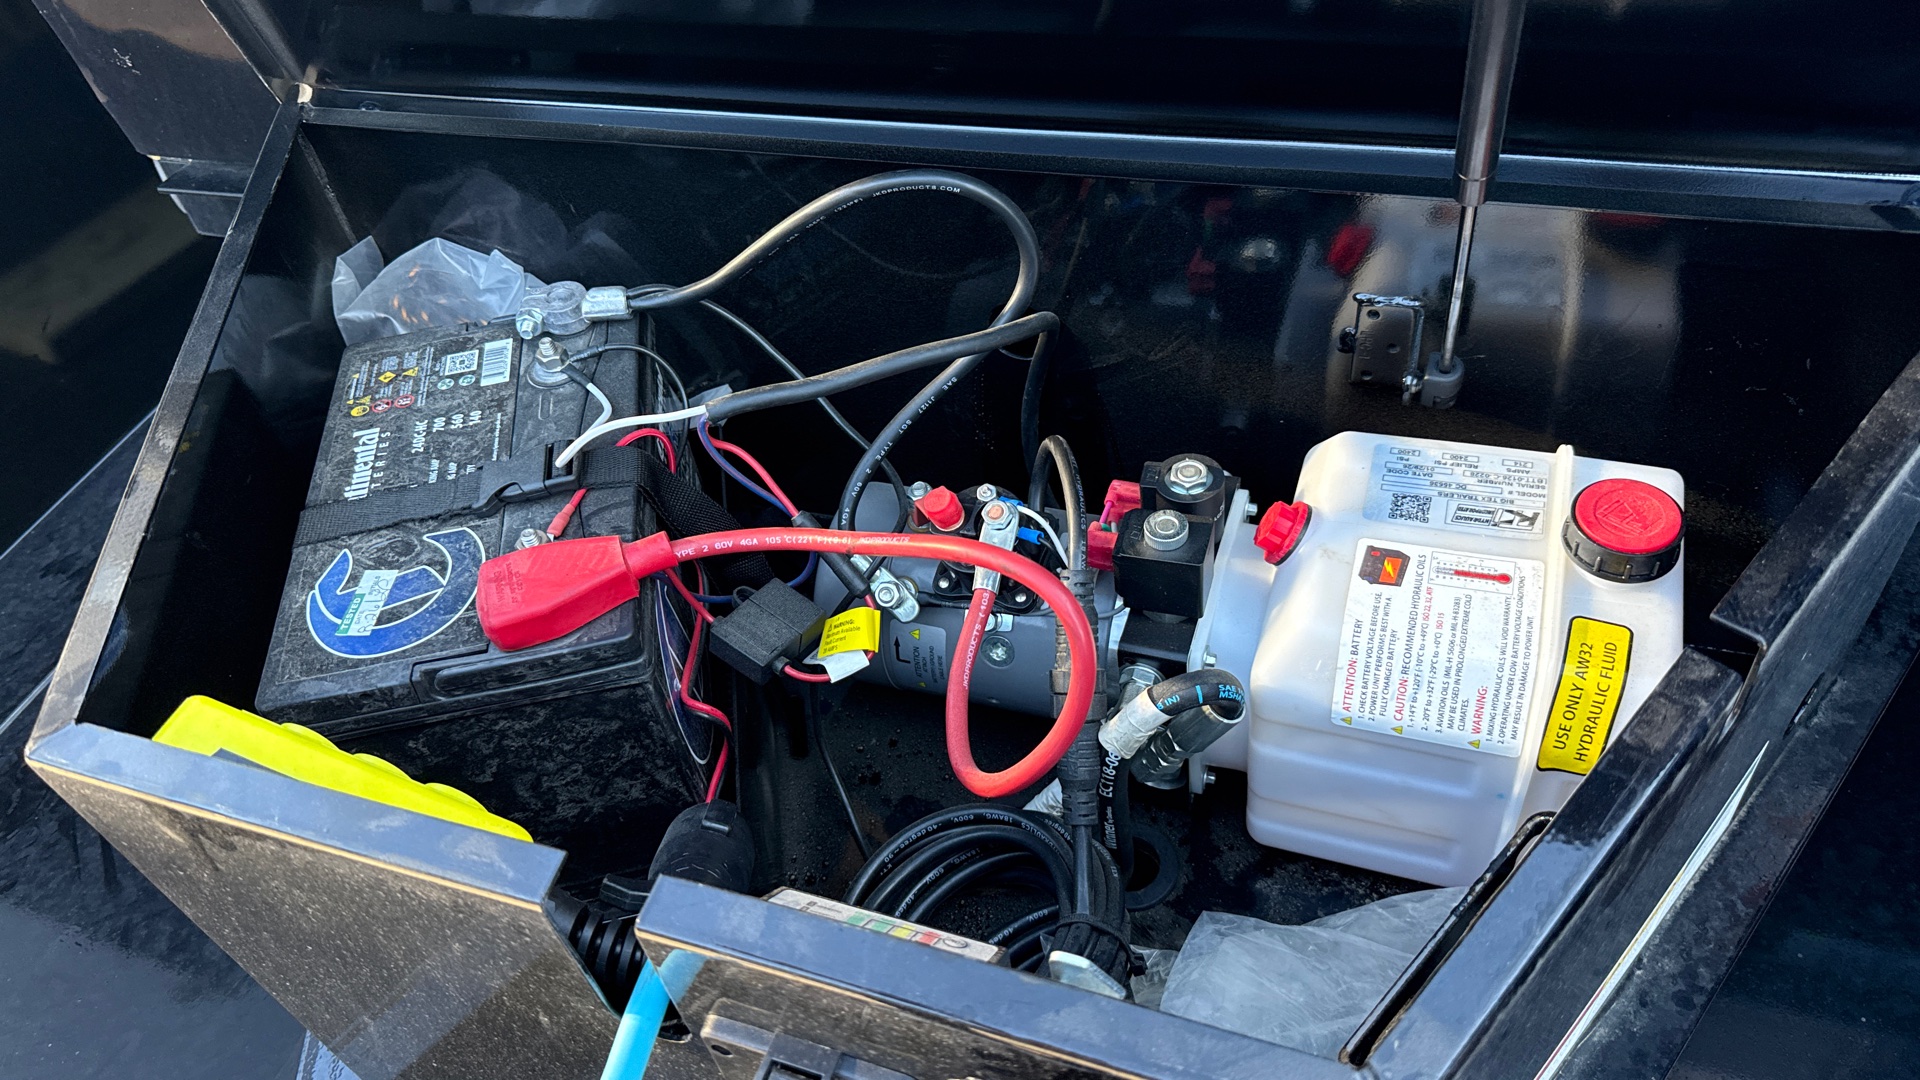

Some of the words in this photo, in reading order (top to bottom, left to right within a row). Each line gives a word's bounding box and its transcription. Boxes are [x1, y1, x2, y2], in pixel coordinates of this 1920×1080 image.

[942, 376, 958, 391] SAE
[918, 396, 935, 414] J1127
[432, 417, 445, 431] 700
[451, 414, 463, 428] 560
[469, 411, 481, 424] 140
[875, 441, 893, 461] TYPE
[1449, 461, 1478, 469] RELIEF
[852, 482, 862, 497] 60V
[1476, 478, 1513, 486] NUMBER
[1076, 474, 1086, 530] HYDRAULICS
[1437, 491, 1478, 500] TRAILERS
[1515, 490, 1545, 498] MODEL
[841, 507, 850, 525] 4GA
[1454, 515, 1489, 523] HYDRAULICS
[1457, 506, 1494, 514] INCORPORATED
[675, 548, 695, 559] YPE
[715, 541, 733, 550] 60V
[740, 538, 758, 546] 4GA
[1463, 593, 1472, 609] COLD
[1516, 575, 1525, 608] CONDITIONS
[340, 597, 360, 629] TESTED
[354, 611, 363, 624] DATE
[1370, 604, 1379, 626] BEFORE
[1382, 602, 1391, 617] WITH
[1514, 608, 1522, 632] VOLTAGE
[1380, 617, 1388, 632] BEST
[1461, 609, 1470, 634] EXTREME
[1365, 627, 1376, 659] VOLTAGE
[1393, 676, 1408, 721] CAUTION:
[1401, 609, 1418, 675] RECOMMENDED
[1410, 570, 1424, 609] HYDRAULIC
[1417, 553, 1426, 569] OILS
[1500, 626, 1508, 640] VOID
[1524, 629, 1533, 650] POWER
[1375, 633, 1386, 671] PERFORMS
[1386, 629, 1397, 659] BATTERY
[1447, 638, 1455, 655] 5606
[1499, 640, 1507, 655] WILL
[1511, 631, 1520, 658] BATTERY
[912, 646, 922, 677] ATTENTION
[1343, 657, 1358, 712] ATTENTION:
[1351, 618, 1363, 655] BATTERY
[1454, 635, 1467, 677] PROLONGED
[1497, 656, 1505, 672] OILS
[1522, 651, 1530, 660] TO
[1573, 641, 1593, 680] AW32
[1361, 659, 1371, 689] BATTERY
[1381, 661, 1393, 694] CHARGED
[1443, 656, 1453, 678] (MIL-H
[1508, 659, 1517, 676] LOW
[1518, 660, 1529, 691] DAMAGE
[1372, 673, 1380, 689] UNIT
[1424, 698, 1431, 706] to
[1432, 650, 1438, 658] to
[1440, 680, 1449, 696] OILS
[1453, 677, 1460, 685] IN
[1505, 676, 1514, 700] UNDER
[1165, 694, 1180, 706] IN)
[1357, 690, 1367, 713] CHECK
[1368, 690, 1378, 715] POWER
[1450, 685, 1459, 704] USED
[1490, 673, 1502, 711] HYDRAULIC
[1562, 682, 1585, 721] ONLY
[1572, 681, 1610, 761] HYDRAULIC
[1599, 641, 1618, 679] FLUID
[1378, 696, 1387, 716] FULLY
[1436, 696, 1446, 727] AVIATION
[1449, 705, 1456, 713] BE
[1457, 697, 1469, 731] CLIMATES.
[1471, 684, 1487, 735] WARNING:
[1512, 700, 1522, 724] RESULT
[1446, 714, 1455, 729] MAY
[1486, 711, 1496, 736] MIXING
[1498, 701, 1510, 738] OPERATING
[1510, 725, 1518, 740] MAY
[1552, 723, 1572, 750] USE
